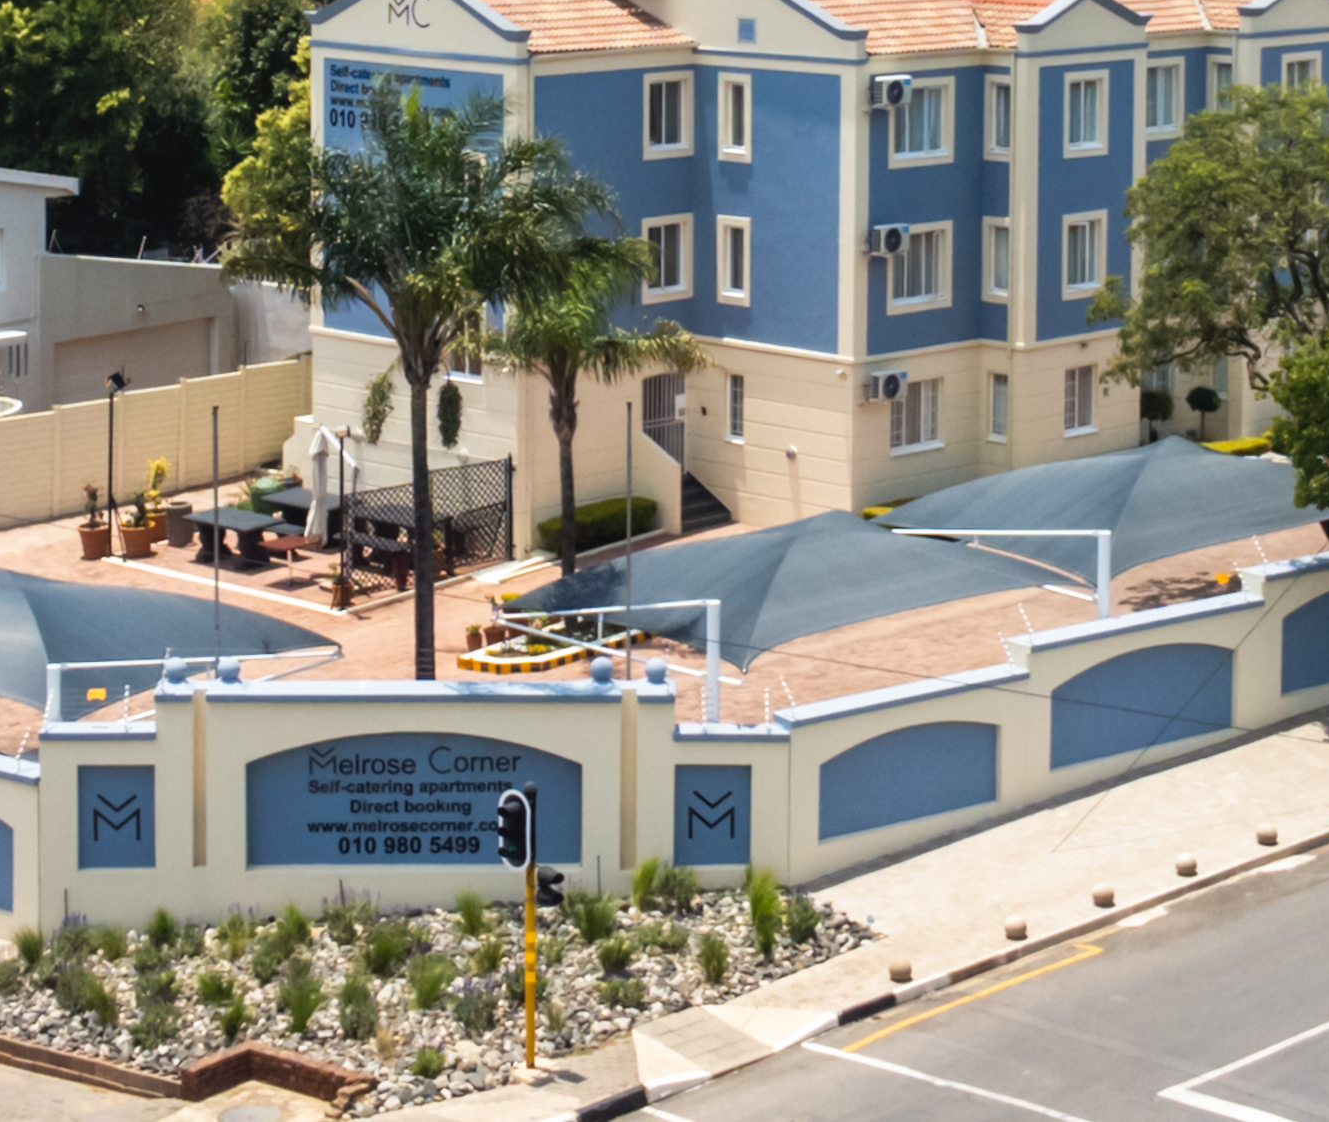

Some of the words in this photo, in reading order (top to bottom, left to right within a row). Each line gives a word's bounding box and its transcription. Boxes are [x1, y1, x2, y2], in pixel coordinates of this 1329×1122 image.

[330, 65, 391, 86] Self-cate
[330, 79, 358, 94] Direct
[329, 108, 355, 128] 010
[308, 746, 416, 775] Melrose
[428, 745, 522, 774] Corner
[308, 779, 414, 796] Self-catering
[419, 780, 513, 795] apartments
[350, 799, 399, 814] Direct
[404, 799, 472, 815] booking
[307, 820, 499, 833] www.melrosecorner.co
[338, 836, 376, 854] 010
[384, 836, 421, 854] 980
[430, 835, 480, 854] 5499
